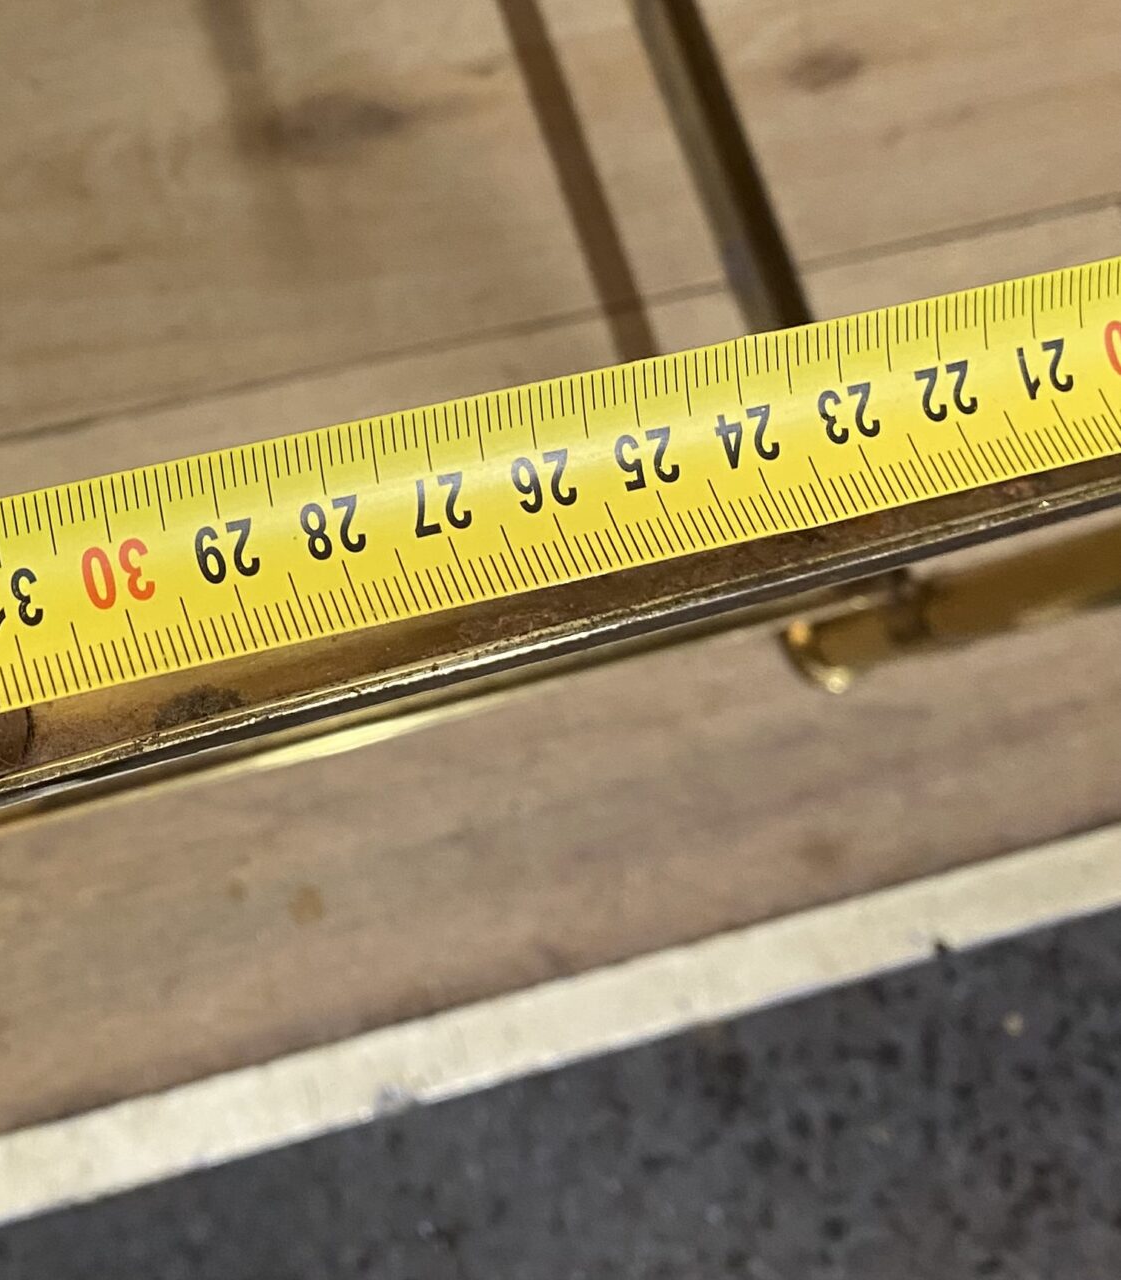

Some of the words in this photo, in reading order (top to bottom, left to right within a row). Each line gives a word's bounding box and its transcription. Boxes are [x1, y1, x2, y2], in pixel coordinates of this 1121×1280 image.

[914, 360, 978, 422] 22
[1016, 337, 1074, 400] 21
[716, 404, 780, 470] 24
[817, 381, 881, 445] 23
[510, 447, 578, 515] 26
[613, 426, 679, 492] 25
[301, 494, 367, 561] 28
[414, 470, 473, 539] 27
[80, 537, 157, 611] 30
[194, 517, 261, 585] 29
